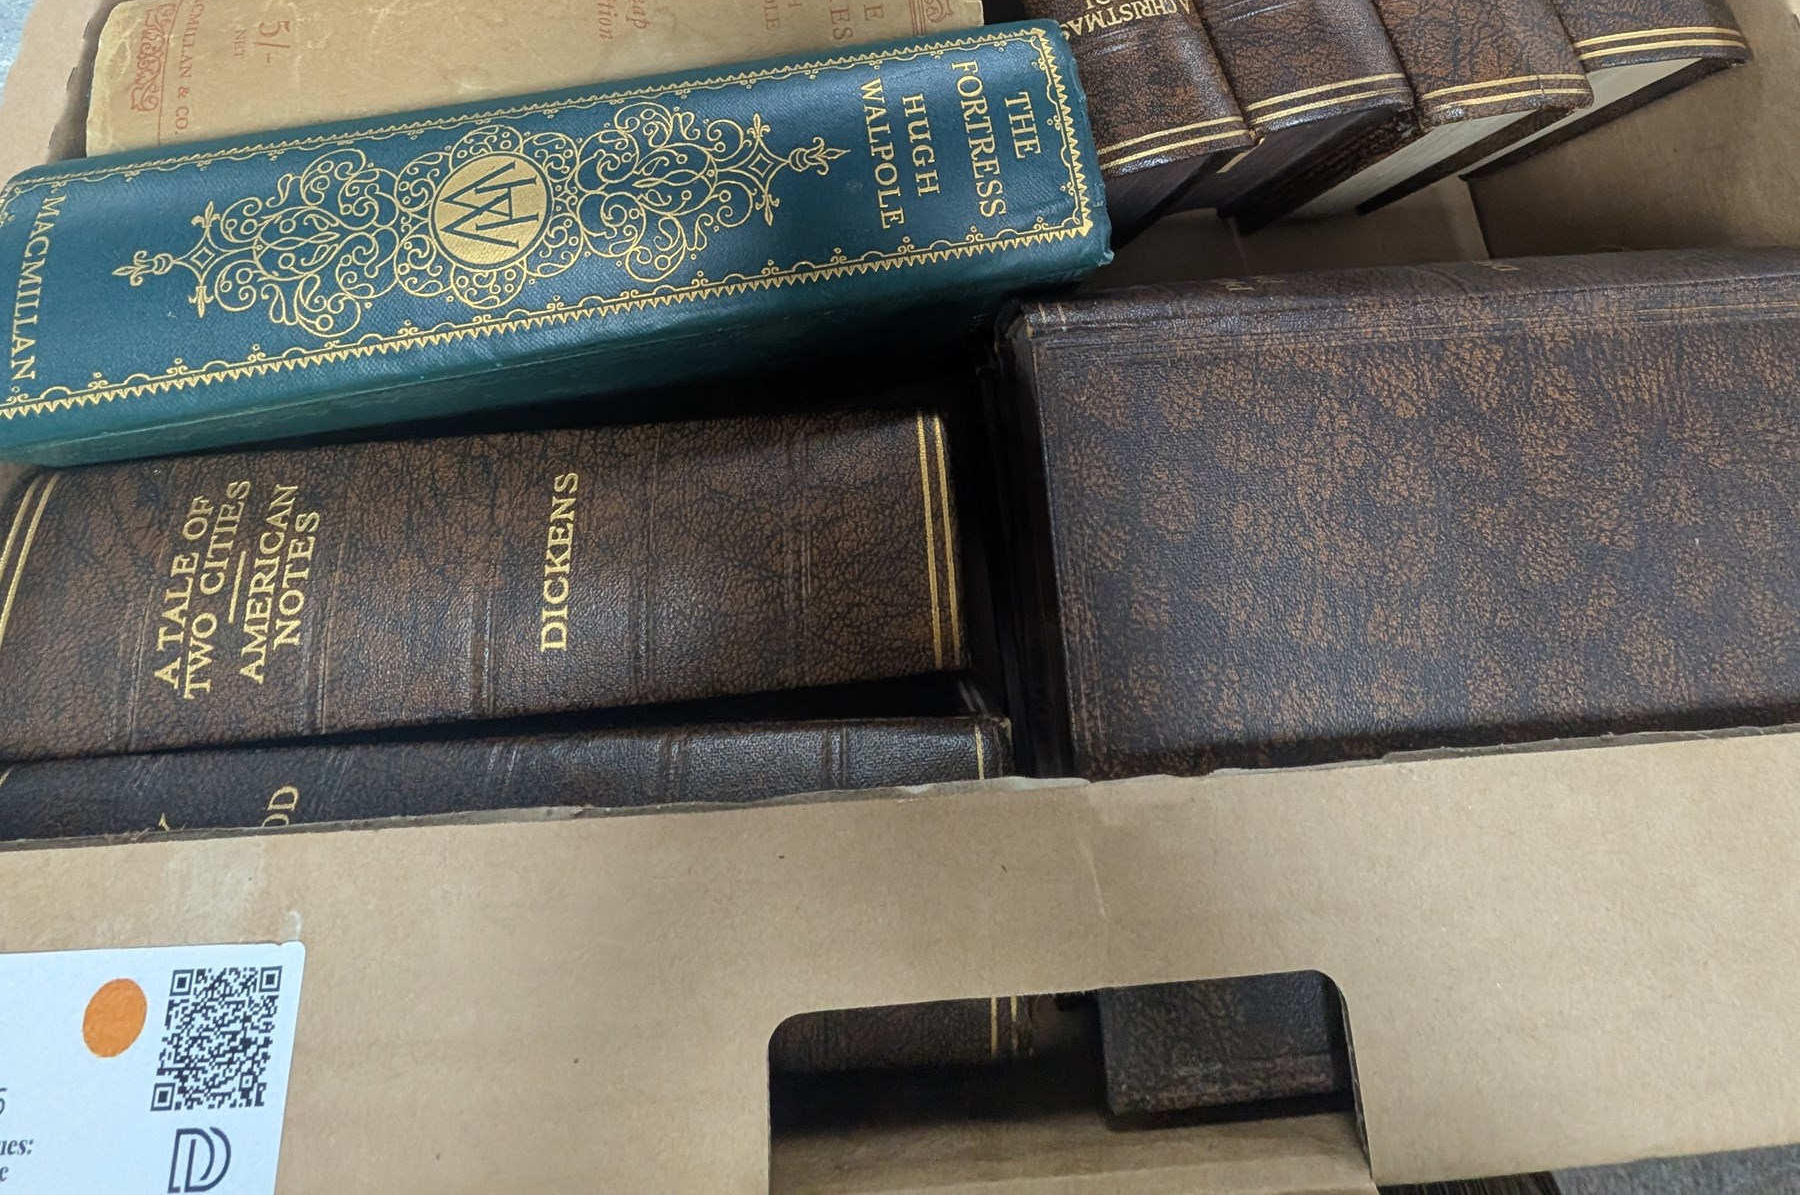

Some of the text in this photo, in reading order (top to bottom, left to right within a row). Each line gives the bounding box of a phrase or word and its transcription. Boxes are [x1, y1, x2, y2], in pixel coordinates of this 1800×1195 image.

[177, 86, 193, 100] &
[234, 28, 247, 59] NET
[173, 105, 190, 136] CO.
[860, 77, 905, 230] WALPOLE
[902, 93, 940, 197] HUGH
[951, 59, 1007, 218] FORTRESS
[1005, 91, 1042, 159] THE
[11, 194, 66, 381] MACMILLAN
[154, 495, 215, 690] A TALE OF
[183, 480, 251, 700] TWO CITIES
[240, 483, 299, 685] AMERICAN
[273, 510, 320, 652] NOTES
[540, 472, 579, 653] DICKENS
